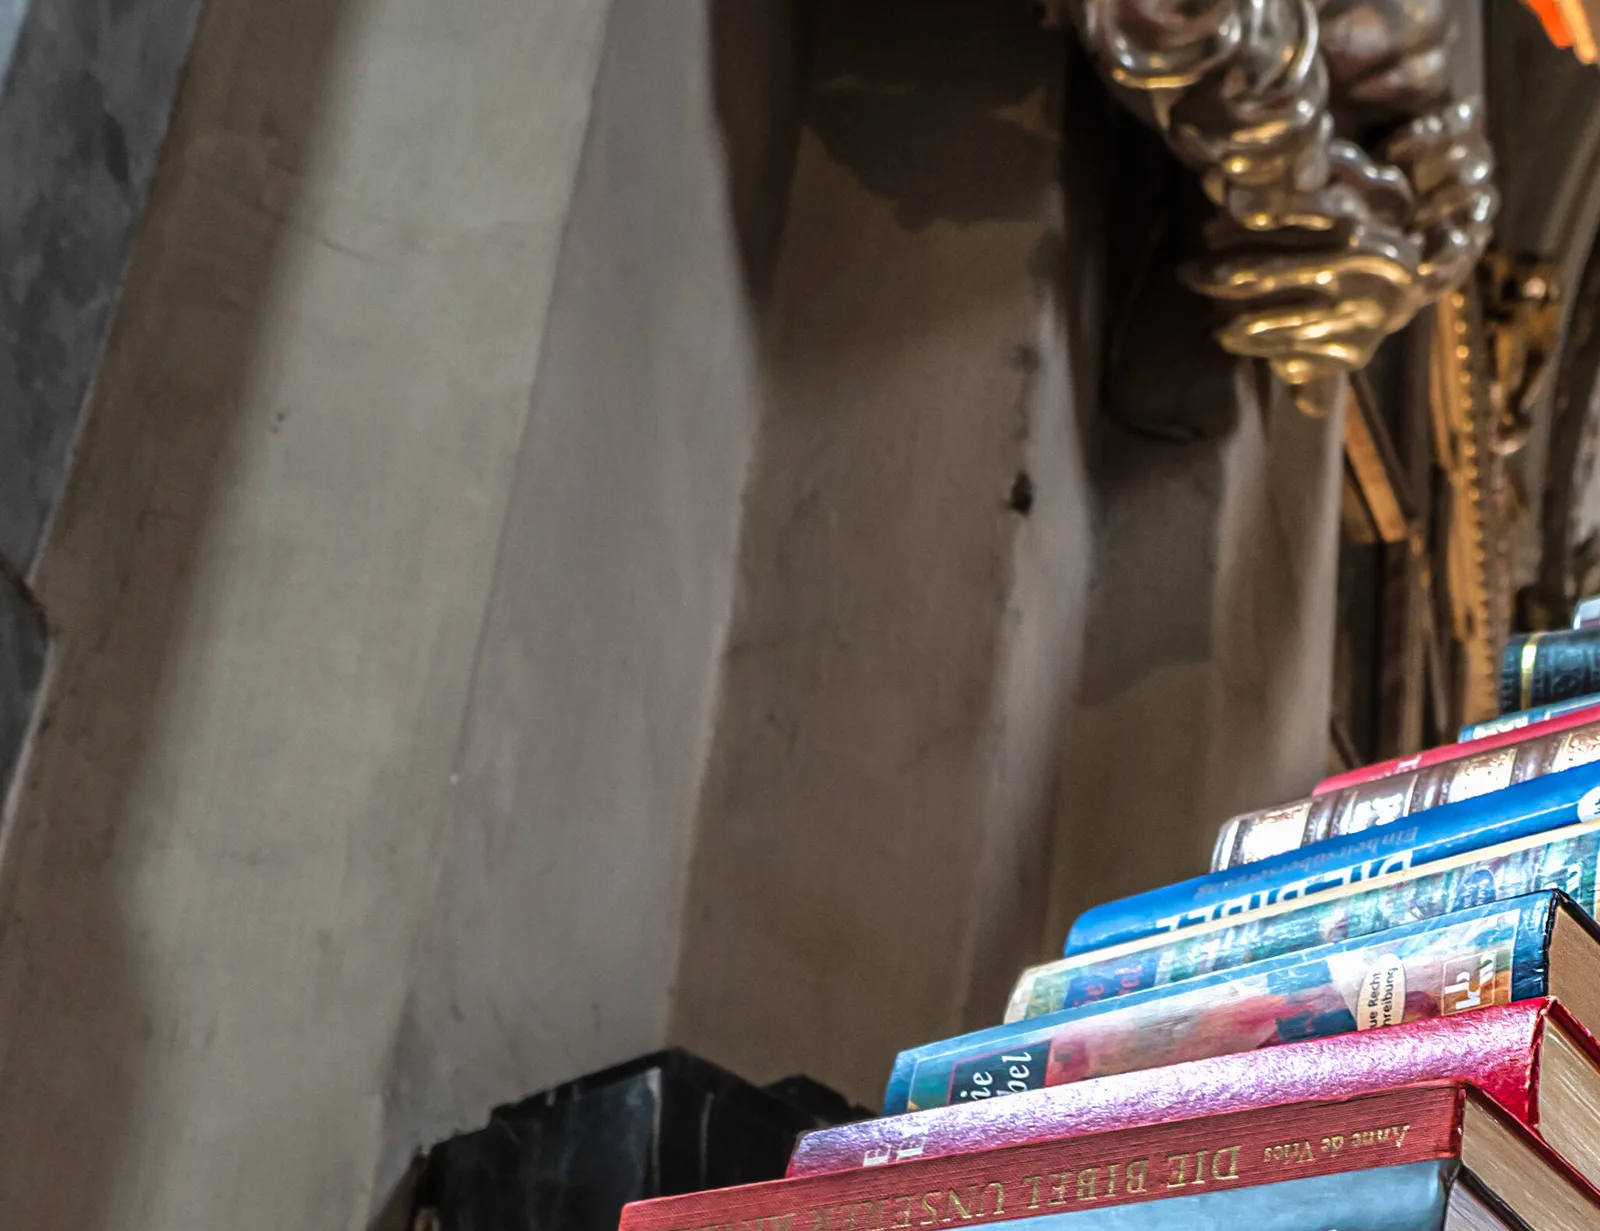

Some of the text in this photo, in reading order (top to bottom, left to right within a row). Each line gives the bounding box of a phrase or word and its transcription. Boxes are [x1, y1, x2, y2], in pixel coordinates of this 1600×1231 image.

[959, 1071, 993, 1101] ie
[1263, 1123, 1411, 1165] Anne de Vries
[1021, 1157, 1149, 1210] BIBEL
[1166, 1145, 1242, 1188] DIE
